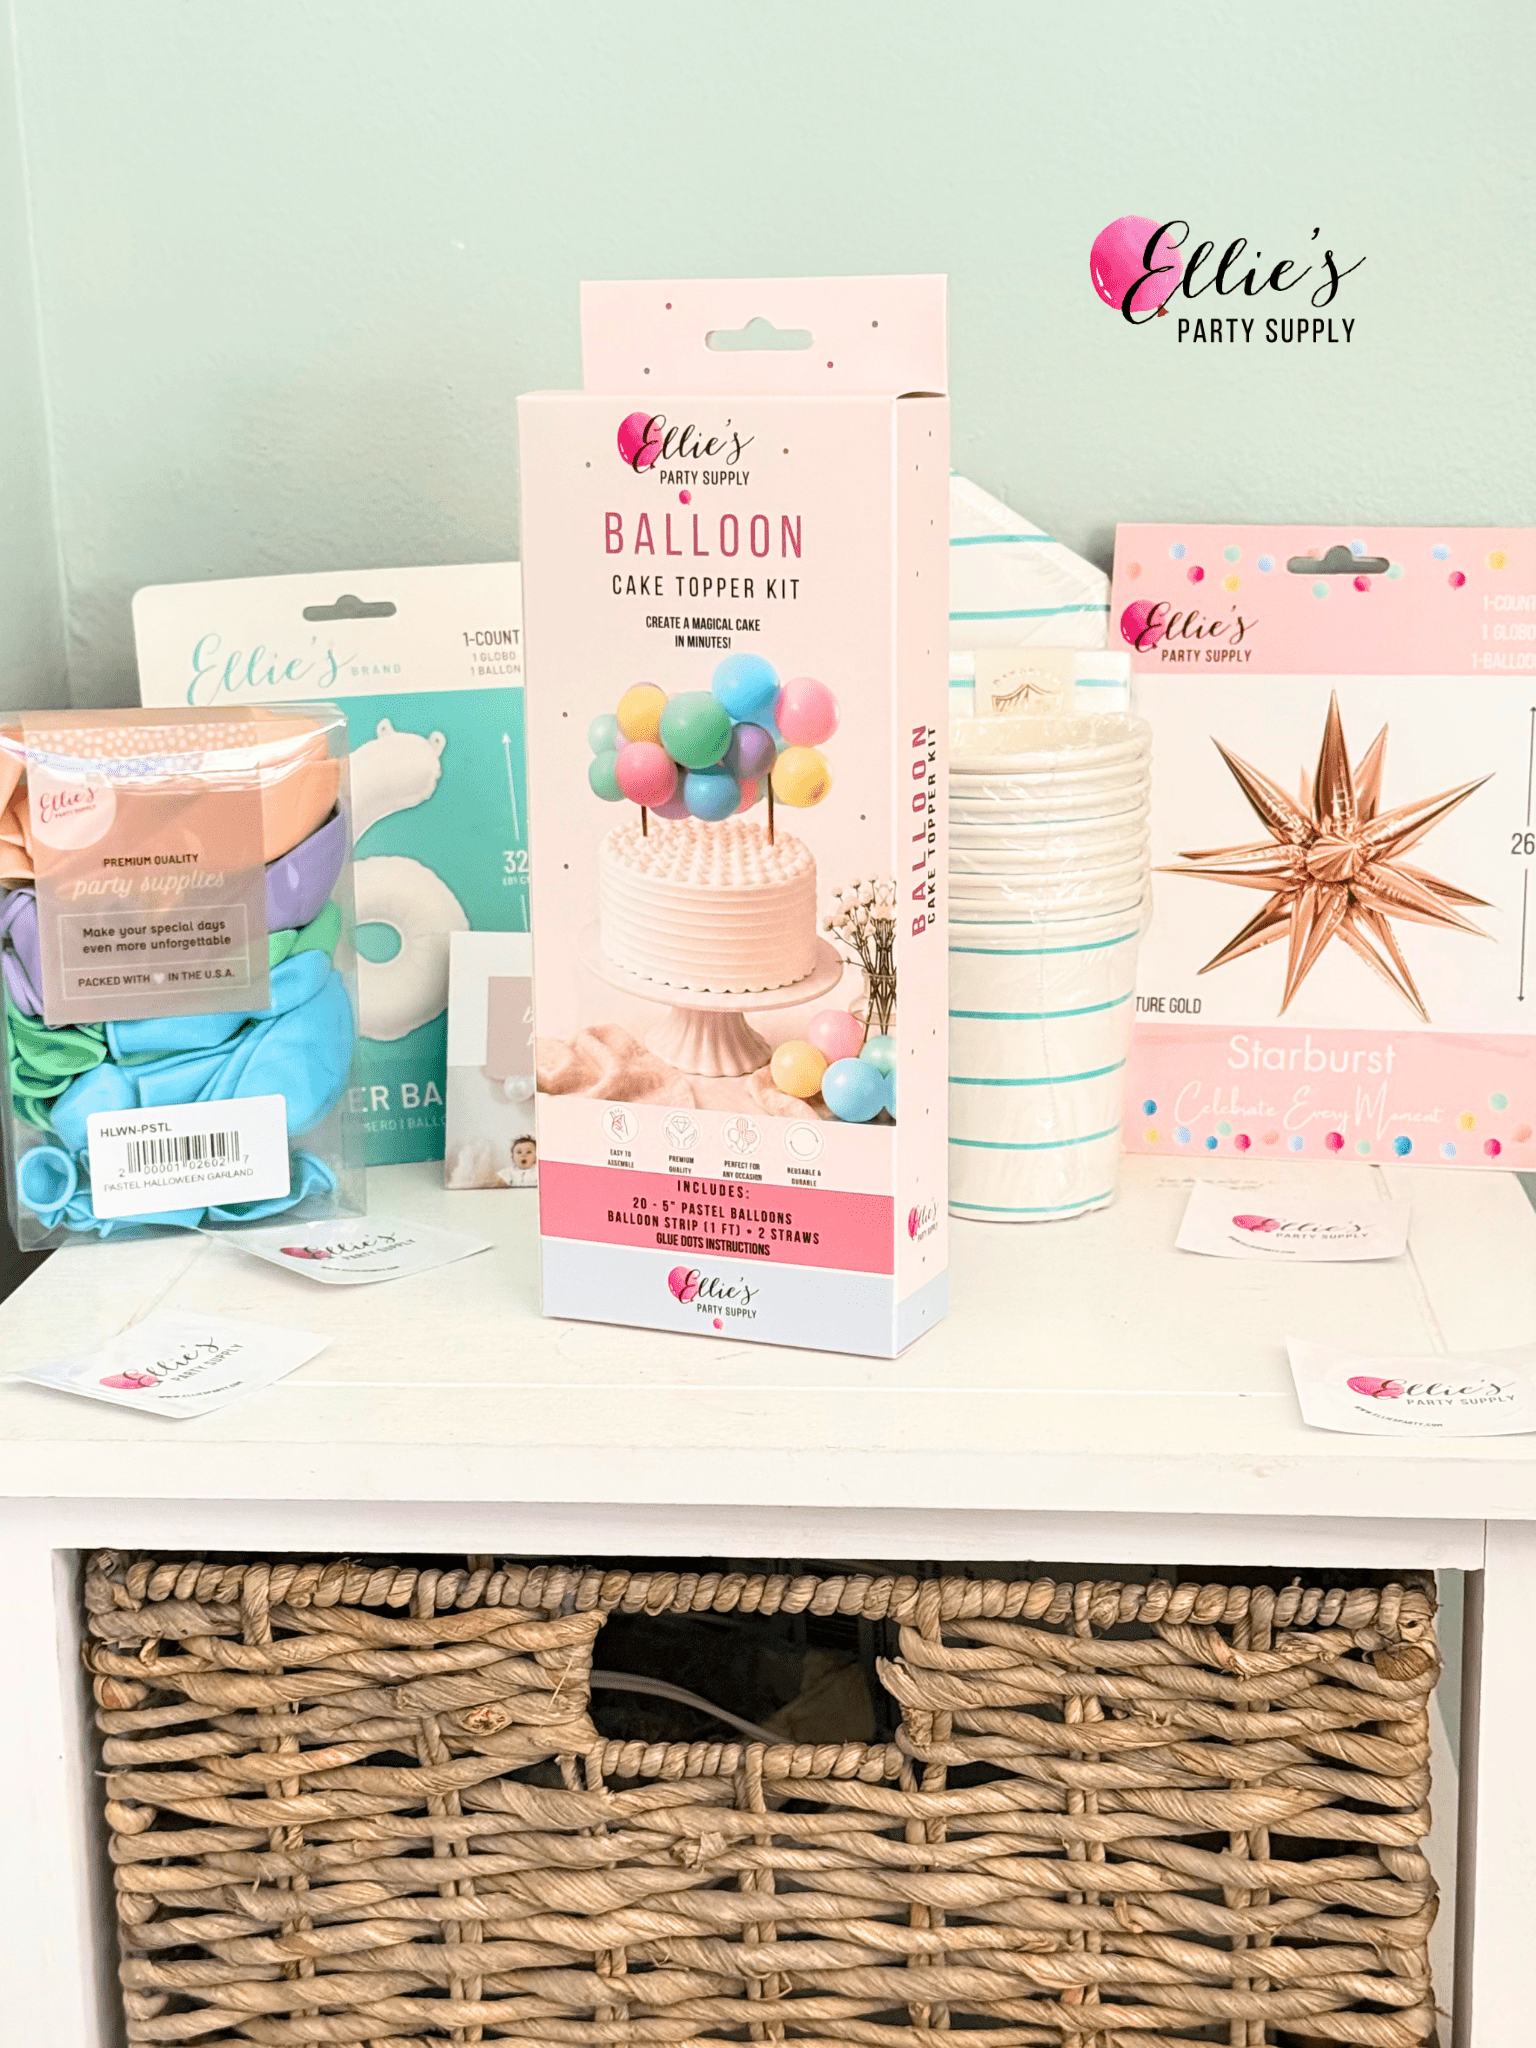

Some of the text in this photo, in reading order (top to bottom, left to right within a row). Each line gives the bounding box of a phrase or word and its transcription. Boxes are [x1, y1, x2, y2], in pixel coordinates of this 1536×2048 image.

[631, 414, 754, 474] Ellie's
[660, 470, 749, 485] PARTY SUPPLY
[605, 512, 801, 558] BALLOON
[612, 574, 800, 600] CAKE TOPPER KIT
[646, 615, 761, 631] CREATE A MAGICAL CAKE
[1134, 601, 1259, 653] Ellie's
[1481, 624, 1489, 640] 1
[463, 629, 520, 647] 1-COUNT
[675, 635, 731, 649] IN MINUTES!
[473, 651, 516, 662] 1 GLOBO
[1162, 649, 1252, 662] PARTY SUPPLY
[187, 632, 358, 706] Ellie's
[351, 664, 401, 676] BRAND
[471, 665, 521, 676] 1 BALLON
[40, 784, 99, 823] Ellie's
[912, 725, 926, 937] BALLOON
[928, 728, 936, 924] CAKE TOPPER KIT
[1511, 832, 1535, 855] 26
[103, 854, 199, 868] PREMIUM QUALITY
[503, 850, 529, 873] 32
[72, 869, 225, 901] party supplies
[83, 919, 226, 940] Make your special days
[83, 934, 231, 954] even more unforgettable
[78, 968, 235, 987] PACKED WITH IN THE U.S.A.
[1136, 996, 1202, 1014] TURE GOLD
[1228, 1034, 1396, 1074] Starburst
[1174, 1079, 1444, 1140] Celebrate Every Moment
[100, 1123, 172, 1137] HLWN-PSTL
[610, 1149, 632, 1158] EASY TO
[669, 1155, 694, 1164] PREMIUM
[118, 1154, 249, 1177] 2 00001 02602 7
[607, 1159, 634, 1168] ASSEMBLE
[669, 1166, 691, 1174] QUALITY
[724, 1160, 760, 1170] PERFECT FOR
[787, 1167, 816, 1176] REUSABLE
[104, 1168, 254, 1192] PASTEL HALLOWEEN GARLAND
[723, 1171, 762, 1181] ANY OCCASION
[791, 1178, 817, 1187] DURABLE
[677, 1180, 750, 1199] INCLUDES:
[633, 1197, 647, 1209] 20
[681, 1202, 725, 1218] PASTEL
[730, 1207, 792, 1225] BALLOONS
[608, 1210, 820, 1245] BALLOON STRIP (1 FT) 2 STRAWS
[656, 1232, 770, 1256] GLUE DOTS INSTRUCTIONS
[678, 1269, 759, 1304] Ellie's
[697, 1303, 757, 1319] PARTY SUPPLY
[123, 1337, 219, 1387] Ellie's
[171, 1343, 243, 1382] PARTY SUPPLY
[1372, 1379, 1515, 1400] Ellie's
[1460, 1395, 1515, 1405] SUPPLY
